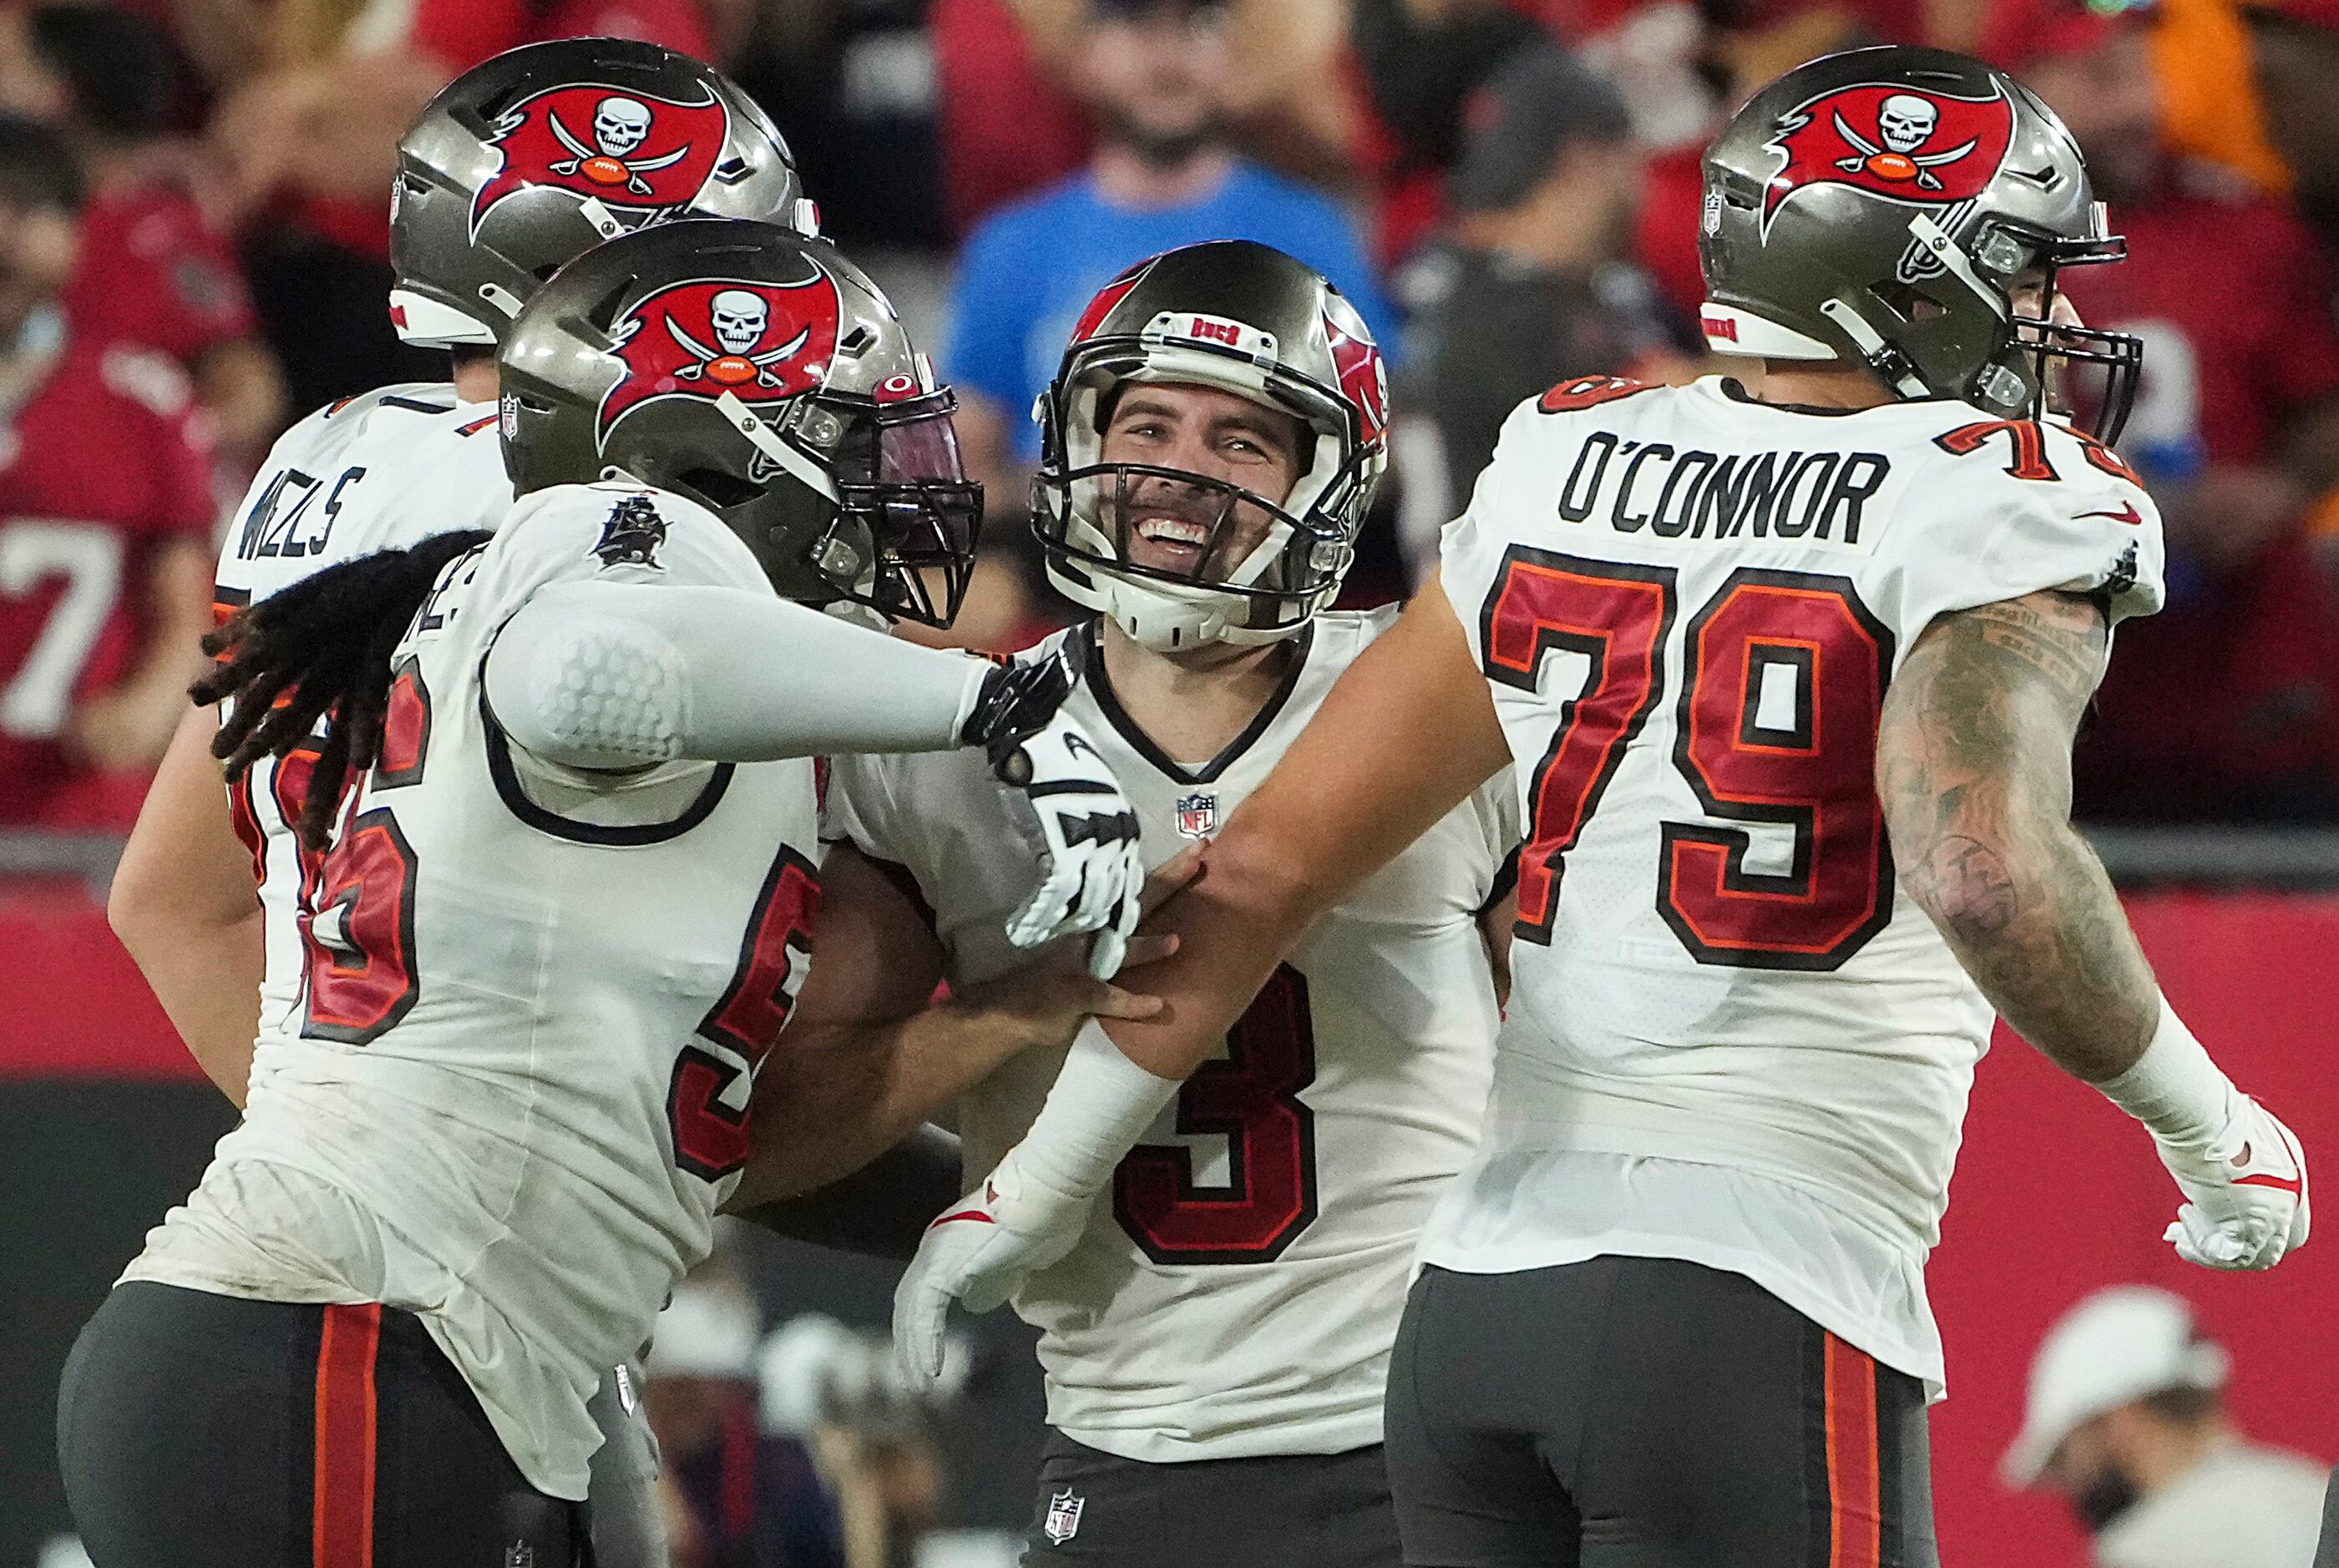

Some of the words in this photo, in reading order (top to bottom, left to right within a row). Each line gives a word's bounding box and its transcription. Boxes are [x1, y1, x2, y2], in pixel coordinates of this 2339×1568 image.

[1558, 431, 1891, 544] O'CONNOR
[1182, 811, 1213, 831] NFL
[1480, 543, 1896, 972] 79
[1112, 960, 1319, 1265] 3
